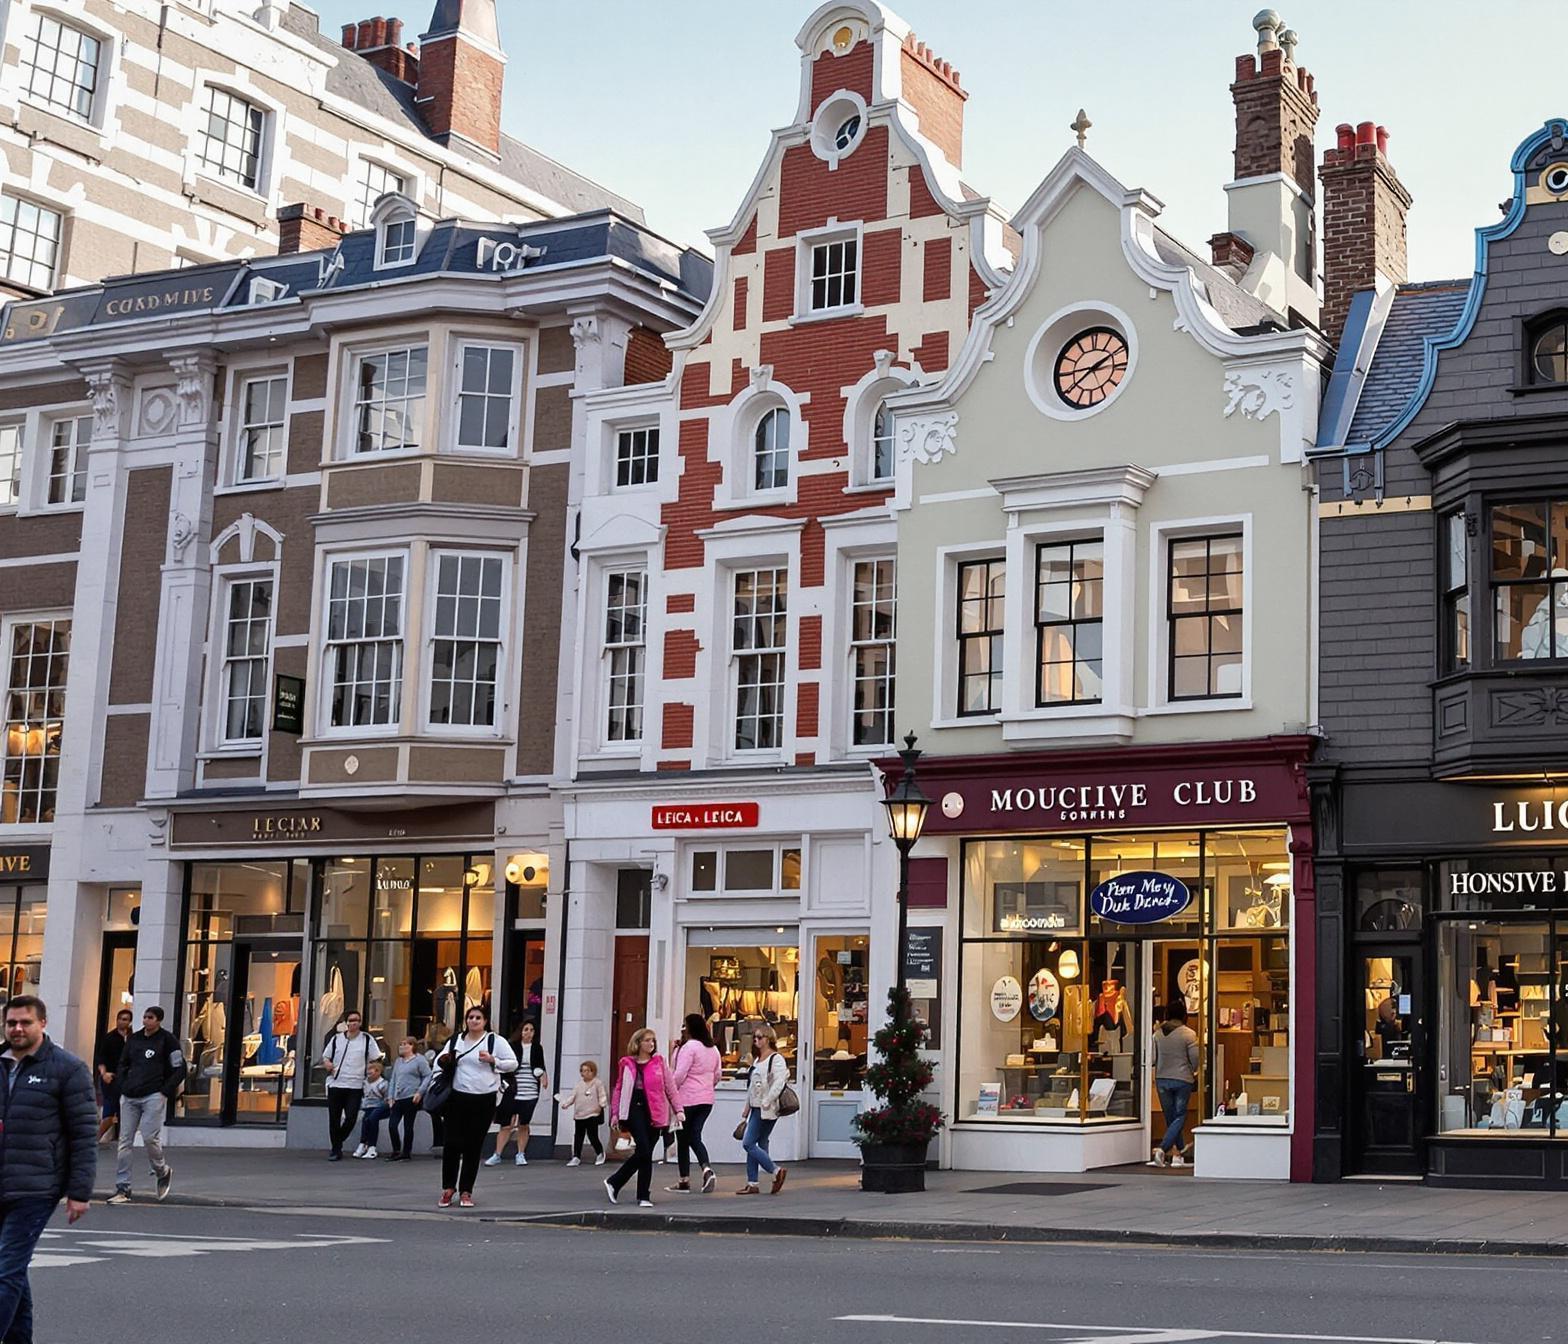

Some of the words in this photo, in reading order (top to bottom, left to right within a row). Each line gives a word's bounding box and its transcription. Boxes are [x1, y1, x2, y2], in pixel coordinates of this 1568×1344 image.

[1173, 780, 1258, 805] CLUB
[657, 811, 692, 824] LEICA
[704, 810, 743, 823] LEICA
